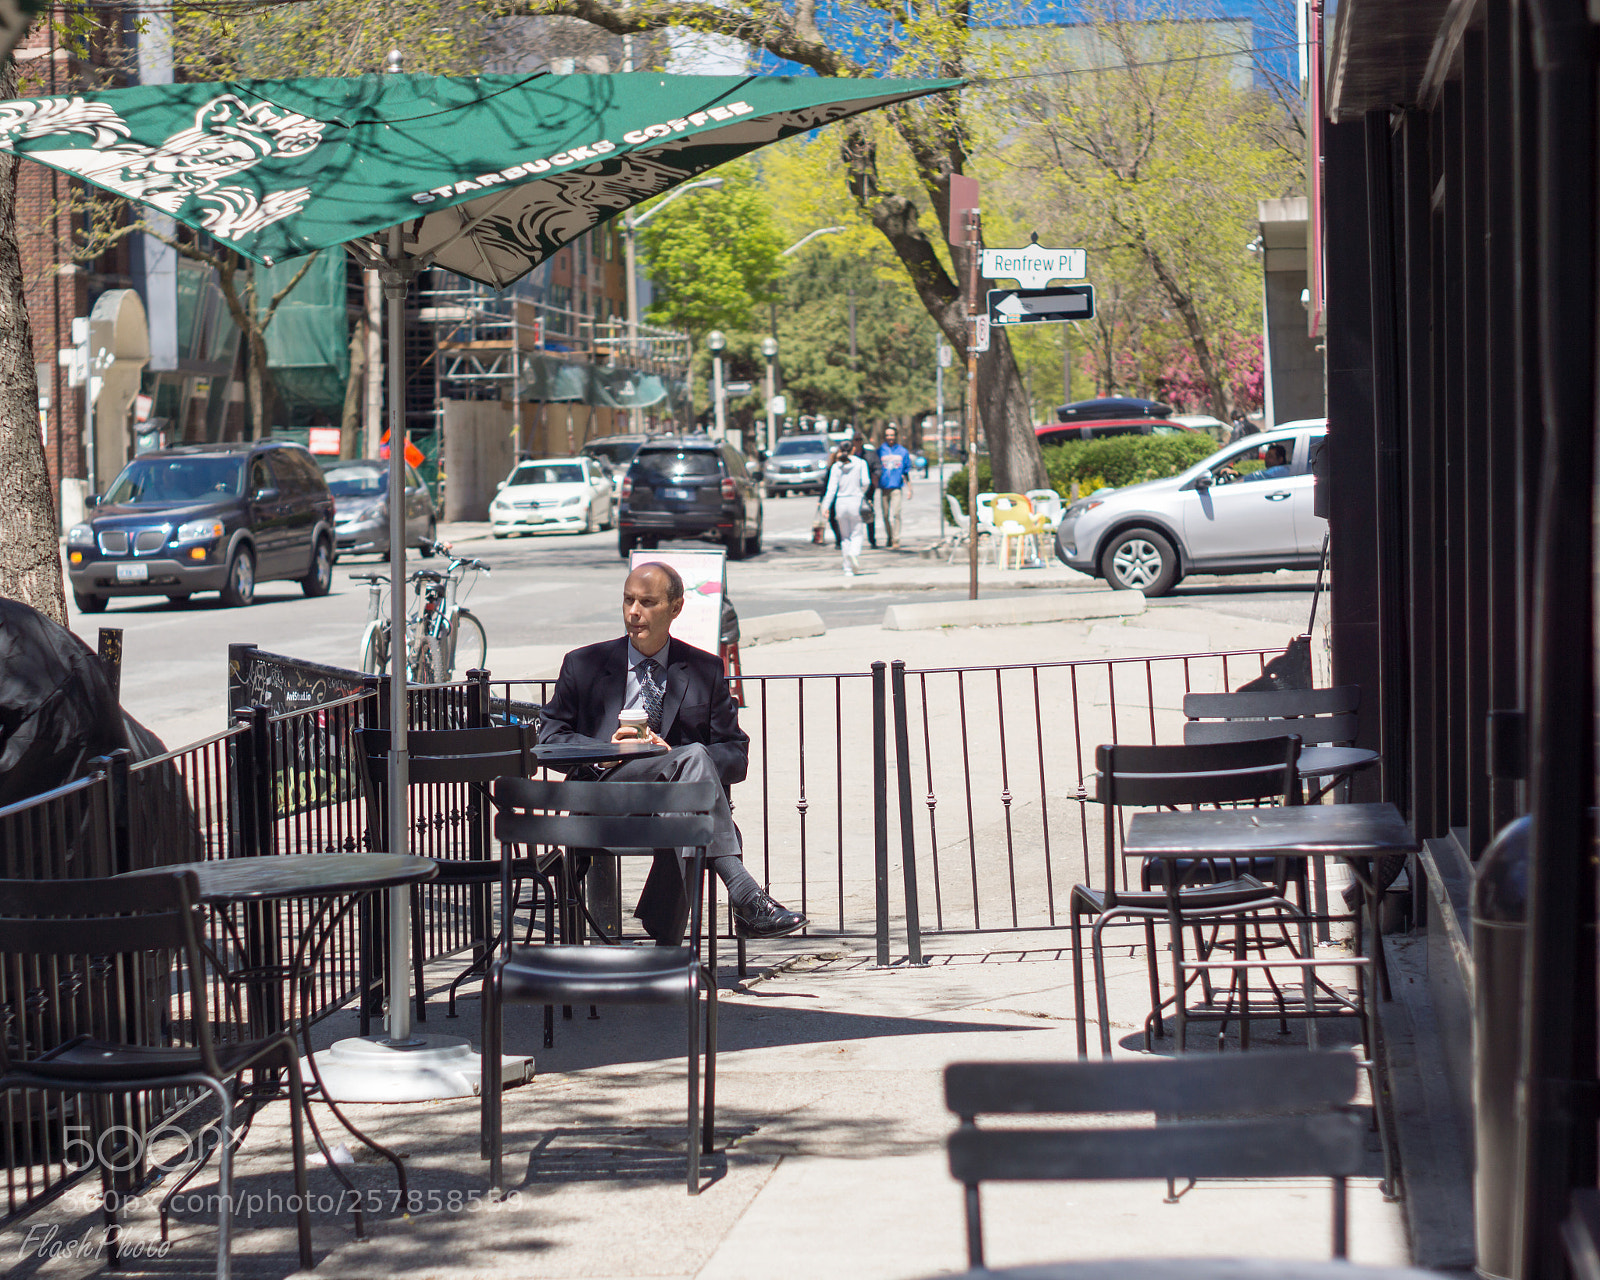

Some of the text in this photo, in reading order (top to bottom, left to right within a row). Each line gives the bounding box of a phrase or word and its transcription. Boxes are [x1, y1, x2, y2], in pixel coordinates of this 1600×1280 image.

[411, 101, 754, 204] STARBUCKS COFFEE
[995, 255, 1072, 271] Renfrew Pl
